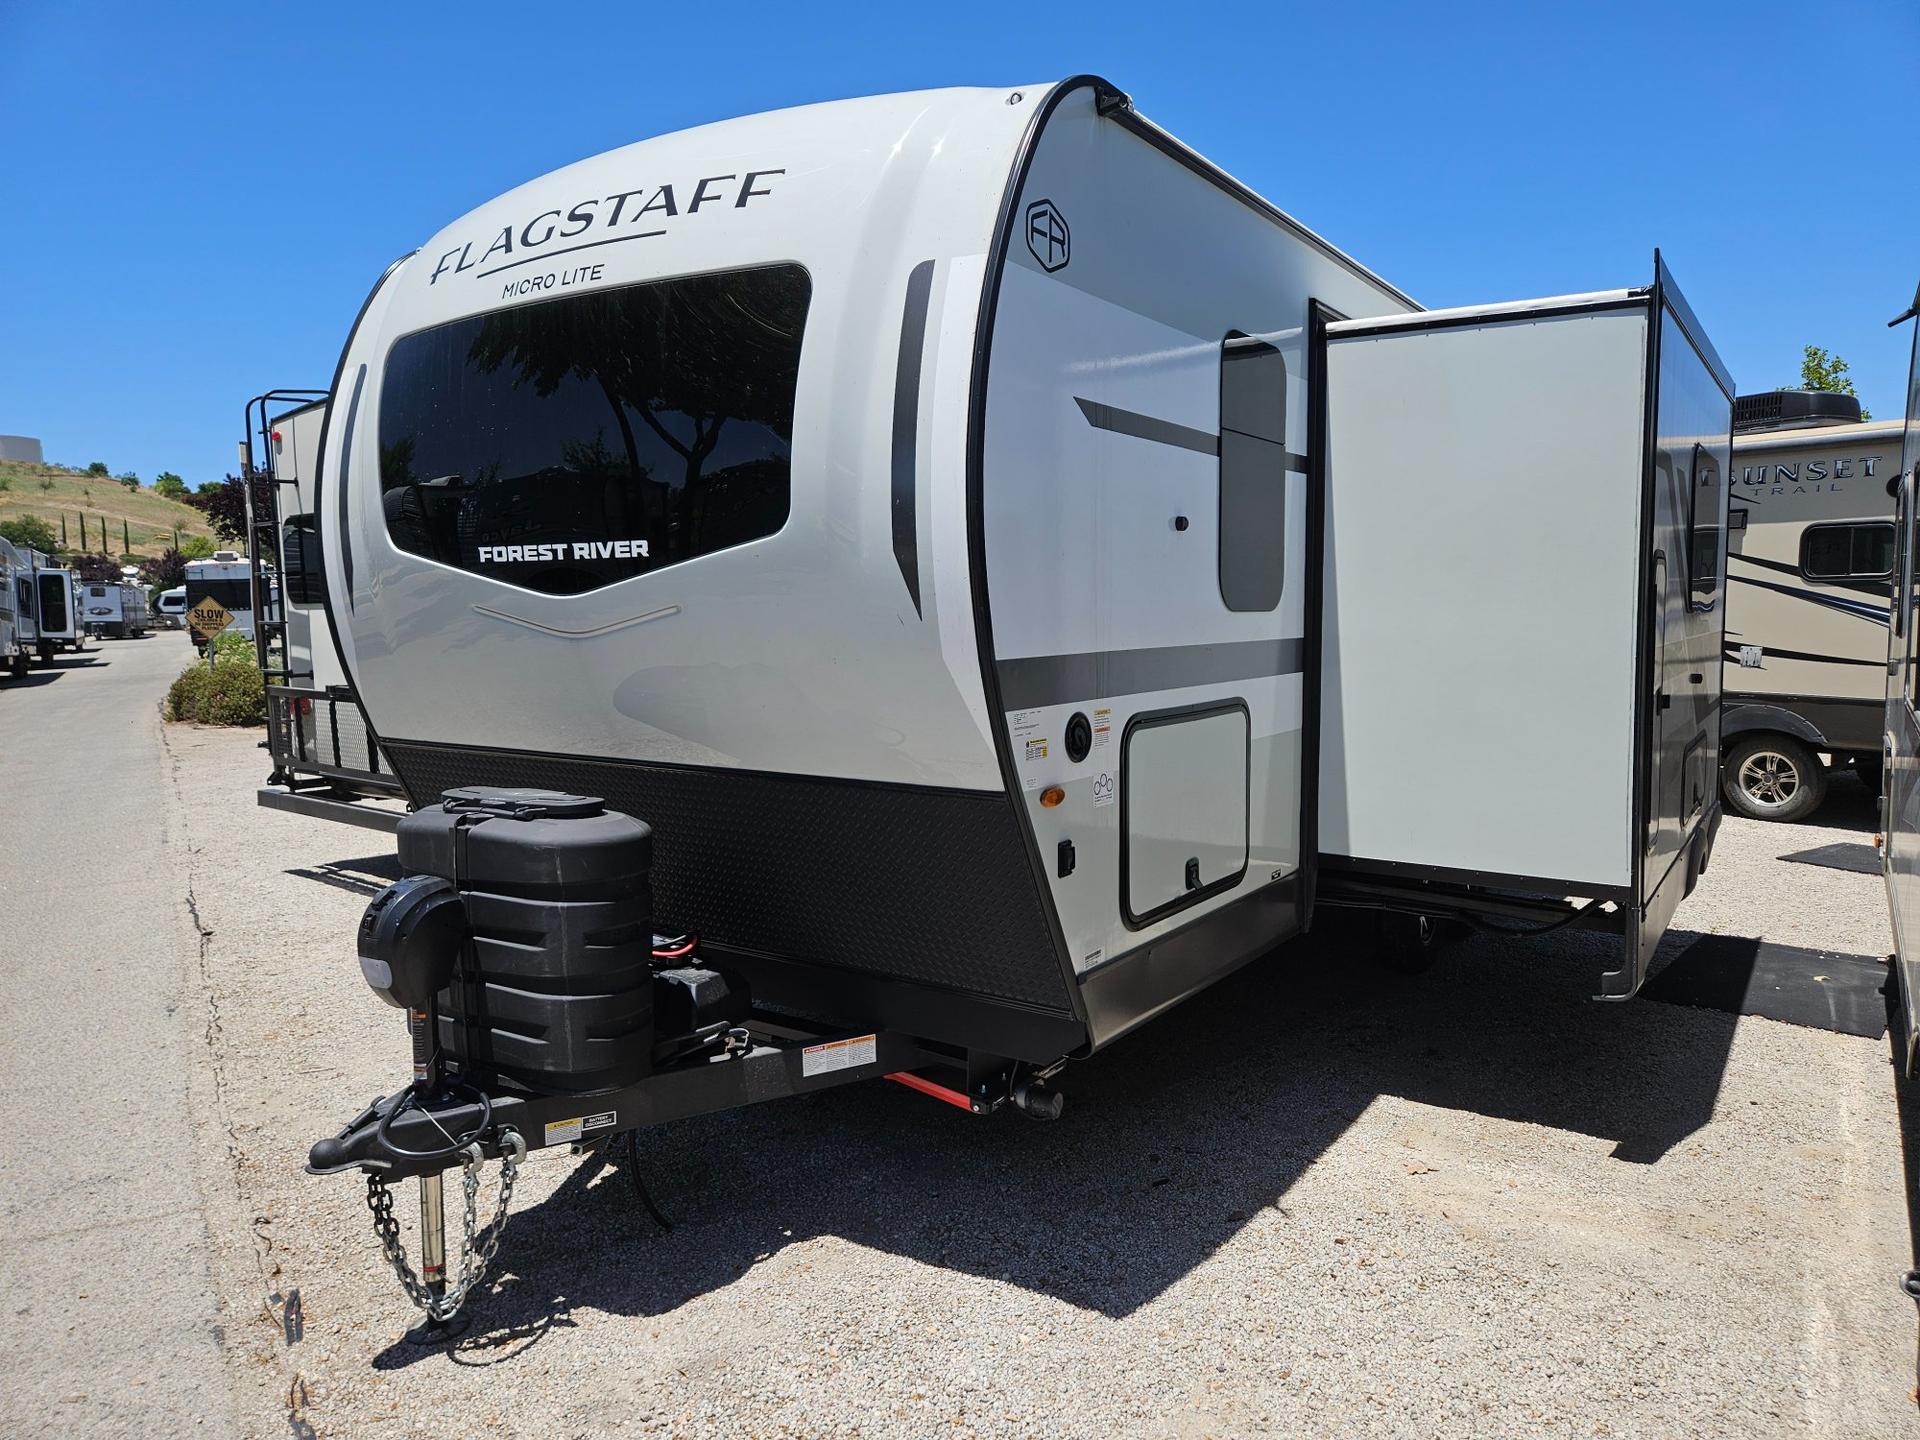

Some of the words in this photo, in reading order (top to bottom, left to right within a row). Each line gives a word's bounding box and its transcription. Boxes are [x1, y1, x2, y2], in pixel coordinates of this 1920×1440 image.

[430, 168, 786, 286] FLAGSTAFF
[501, 273, 556, 300] MICRO
[561, 263, 605, 286] LITE
[1752, 483, 1844, 497] TRAIL
[478, 544, 568, 562] FOREST
[571, 540, 650, 560] RIVER
[194, 609, 224, 618] SLOW
